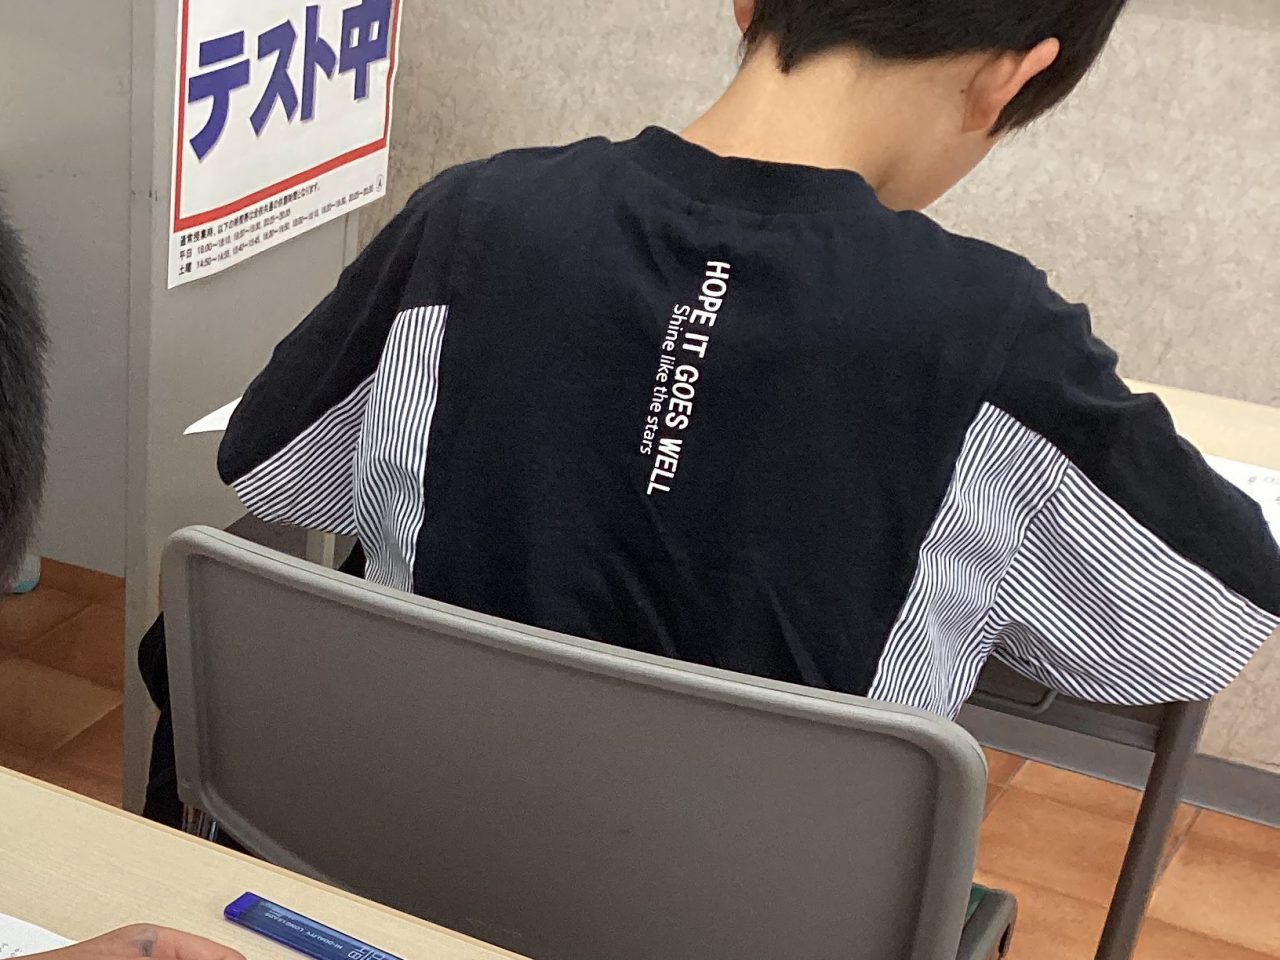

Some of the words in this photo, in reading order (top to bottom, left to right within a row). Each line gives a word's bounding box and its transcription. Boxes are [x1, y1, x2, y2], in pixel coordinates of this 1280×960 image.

[188, 0, 393, 161] テスト中
[689, 261, 731, 328] HOPE
[661, 303, 691, 351] Shine
[682, 332, 710, 359] IT
[655, 354, 676, 383] like
[649, 386, 668, 413] the
[665, 365, 700, 430] GOES
[640, 416, 659, 455] stars
[646, 438, 683, 495] WELL
